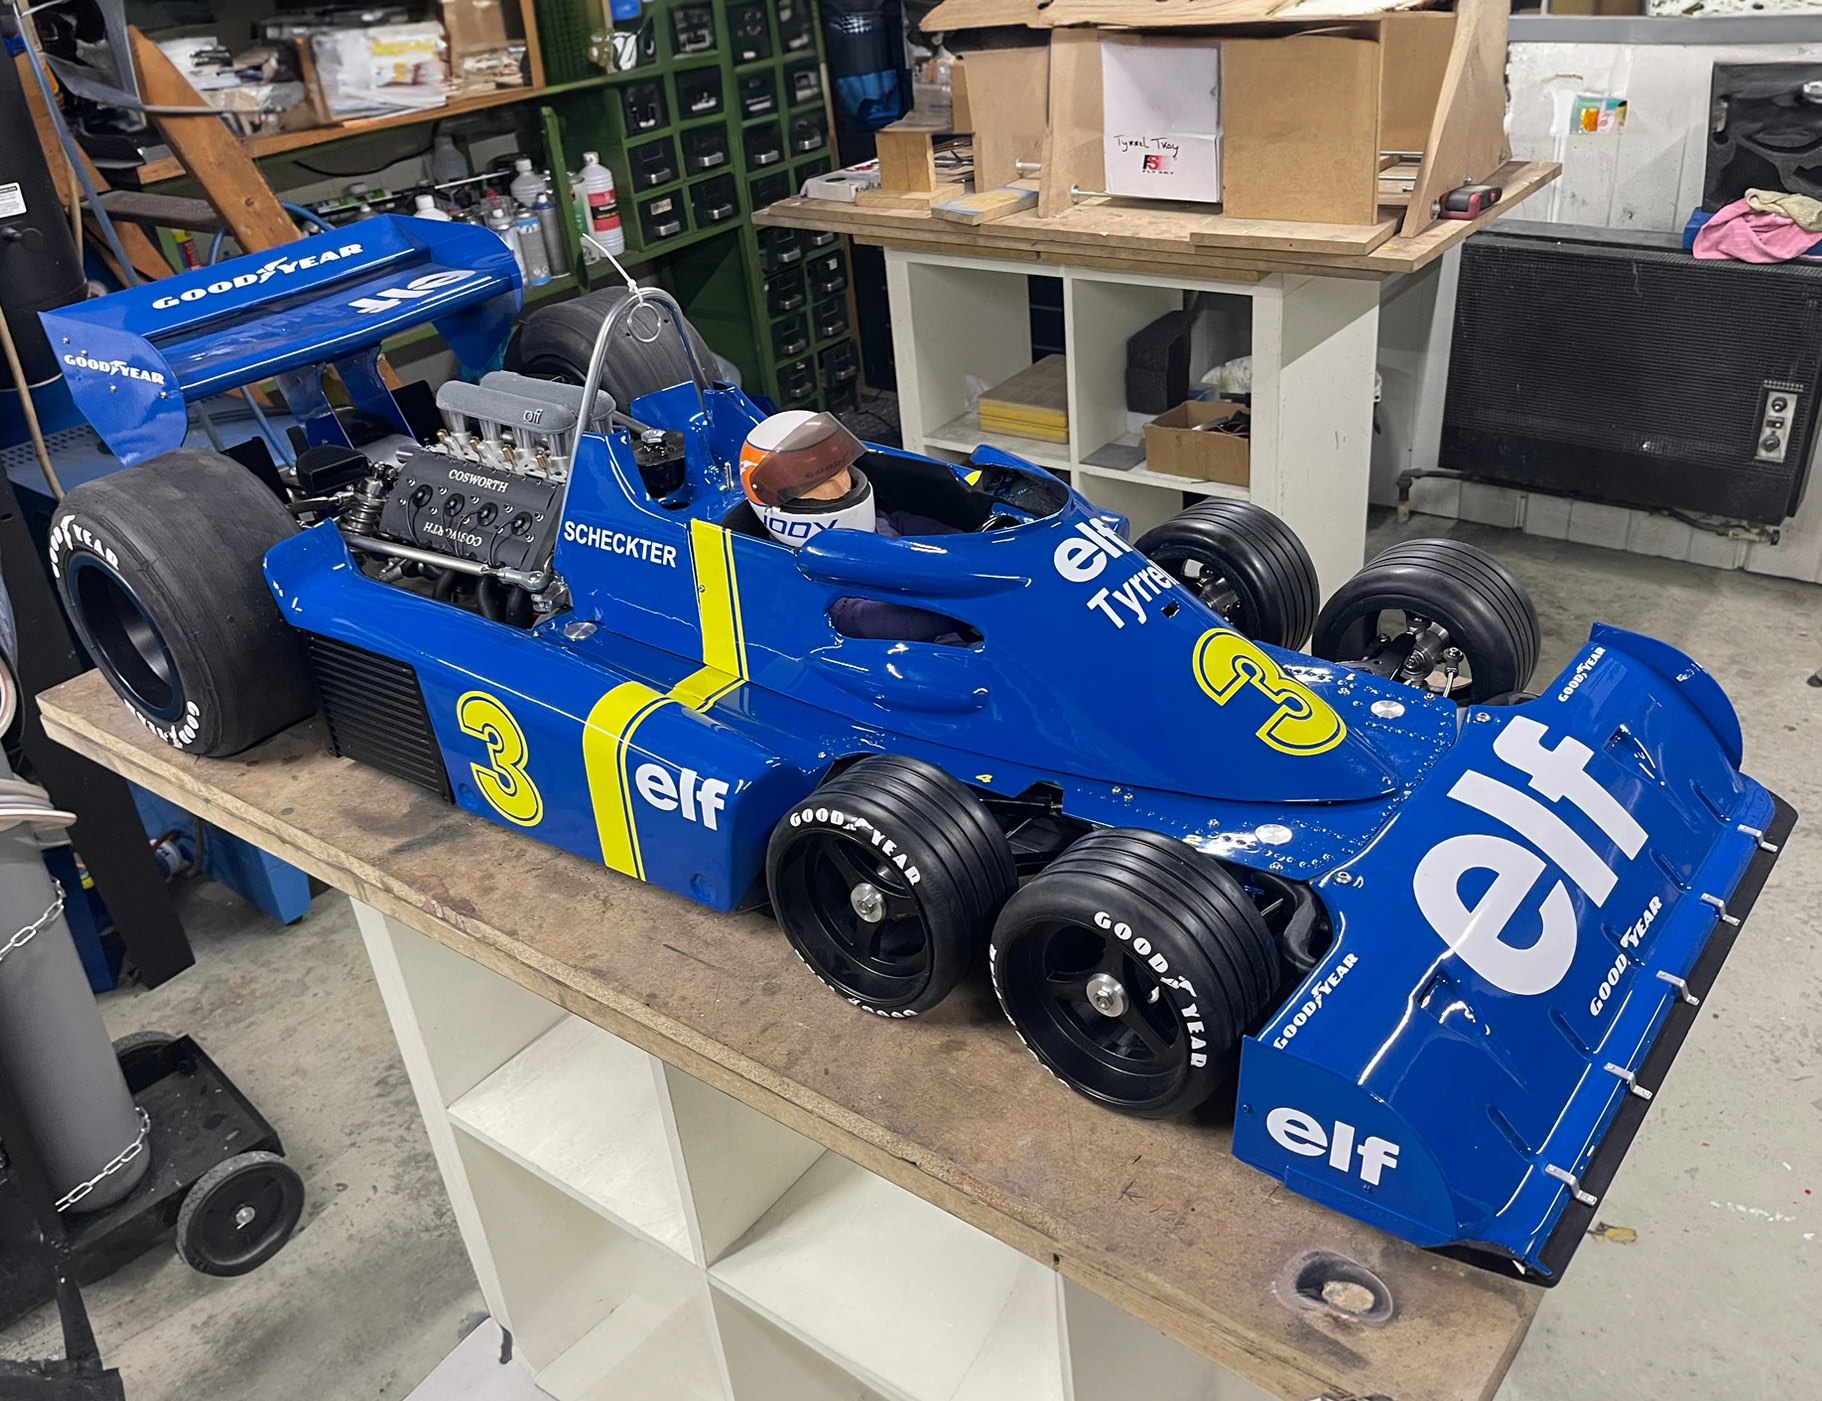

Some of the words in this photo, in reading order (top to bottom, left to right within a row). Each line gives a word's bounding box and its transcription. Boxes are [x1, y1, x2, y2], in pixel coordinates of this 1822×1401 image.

[448, 469, 509, 493] COSWORTH
[563, 520, 677, 568] SCHECKTER
[1053, 517, 1133, 583] elf
[1192, 627, 1347, 756] 3
[456, 691, 544, 828] 3
[634, 762, 730, 832] elf
[1412, 715, 1649, 996] elf
[1265, 1106, 1400, 1186] elf
